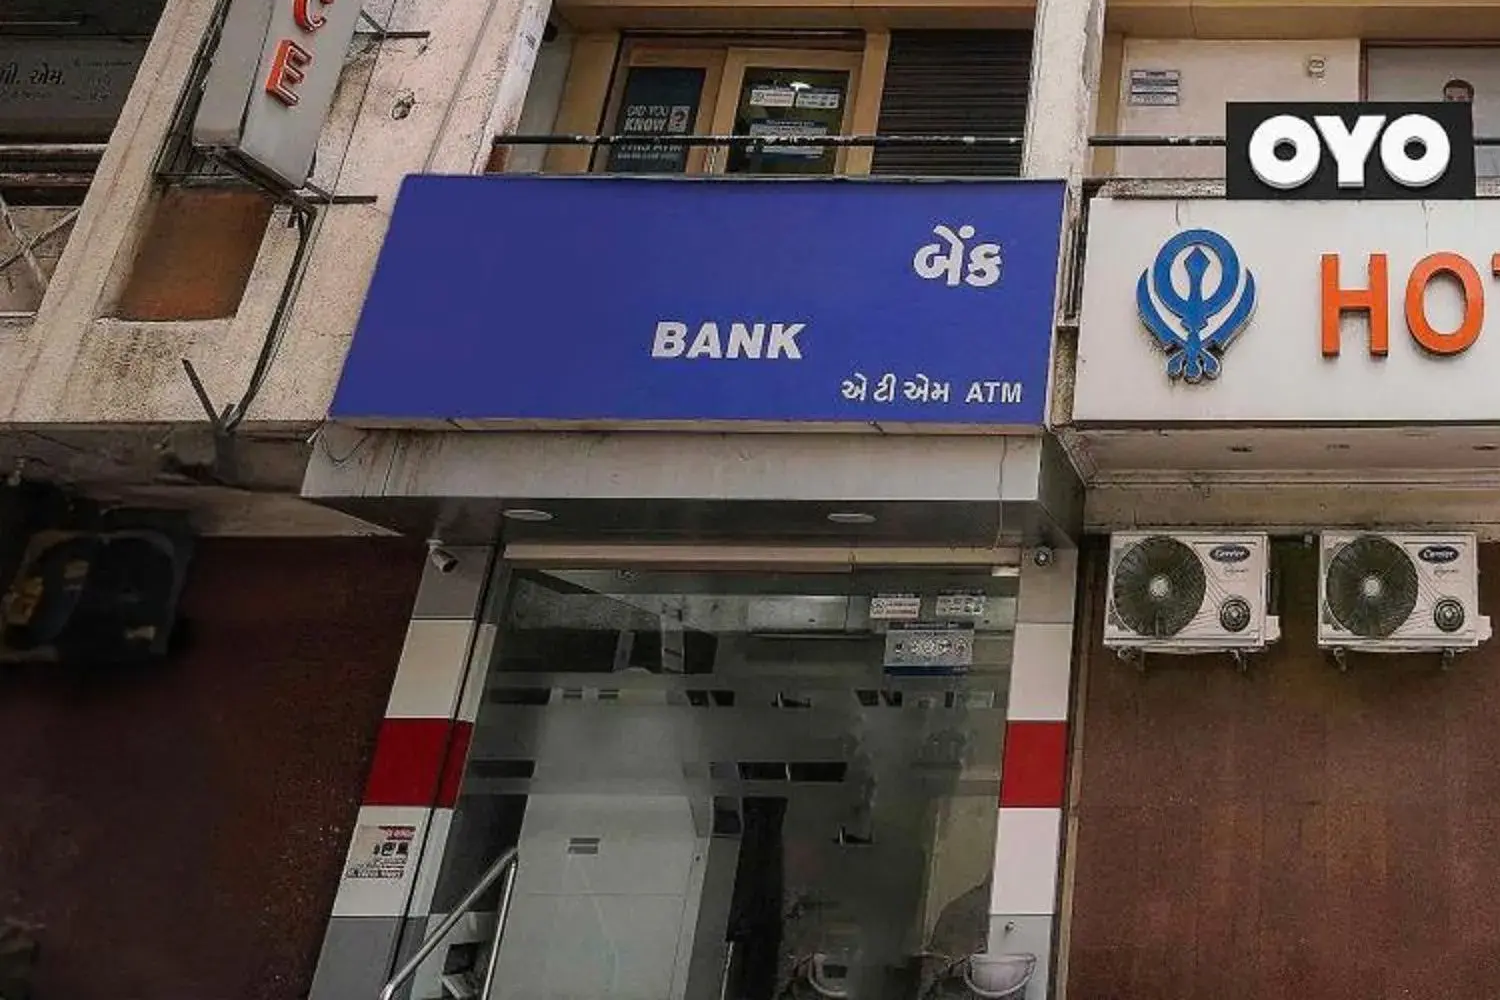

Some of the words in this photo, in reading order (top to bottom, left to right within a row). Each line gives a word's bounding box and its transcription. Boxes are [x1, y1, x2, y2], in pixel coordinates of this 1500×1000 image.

[624, 117, 667, 132] KNOW
[1248, 113, 1452, 190] OYO
[913, 224, 1003, 287] બેંક
[651, 321, 806, 360] BANK
[965, 381, 1023, 403] ATM
